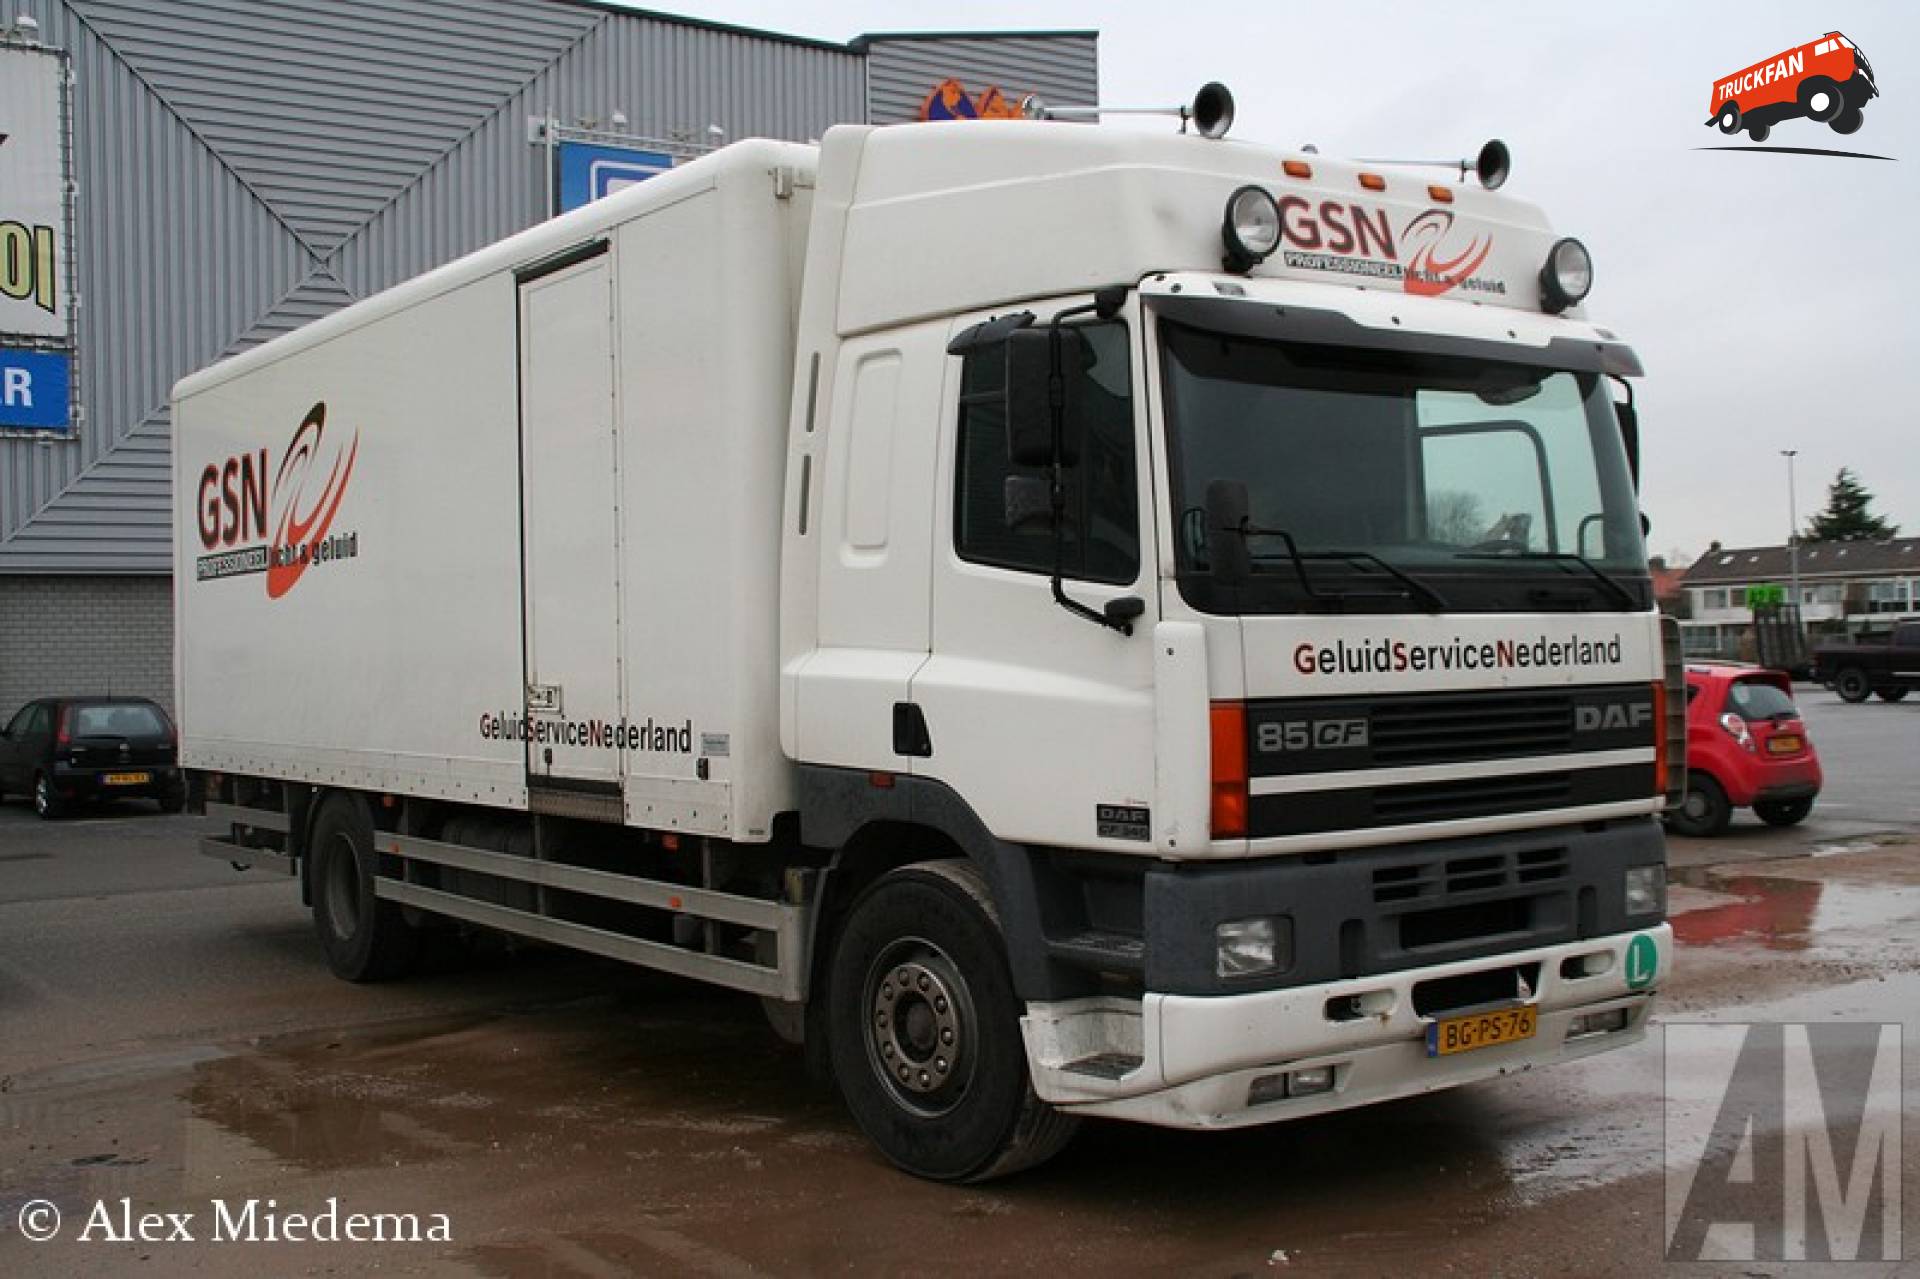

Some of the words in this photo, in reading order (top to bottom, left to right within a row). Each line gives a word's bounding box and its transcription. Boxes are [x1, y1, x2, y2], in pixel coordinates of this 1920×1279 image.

[1279, 194, 1397, 260] GSN
[198, 447, 268, 549] GSN
[1294, 633, 1621, 674] GeluidServiceNederland
[480, 710, 692, 753] GeluidServiceNederland
[1574, 701, 1652, 732] DAF
[1634, 943, 1650, 982] L
